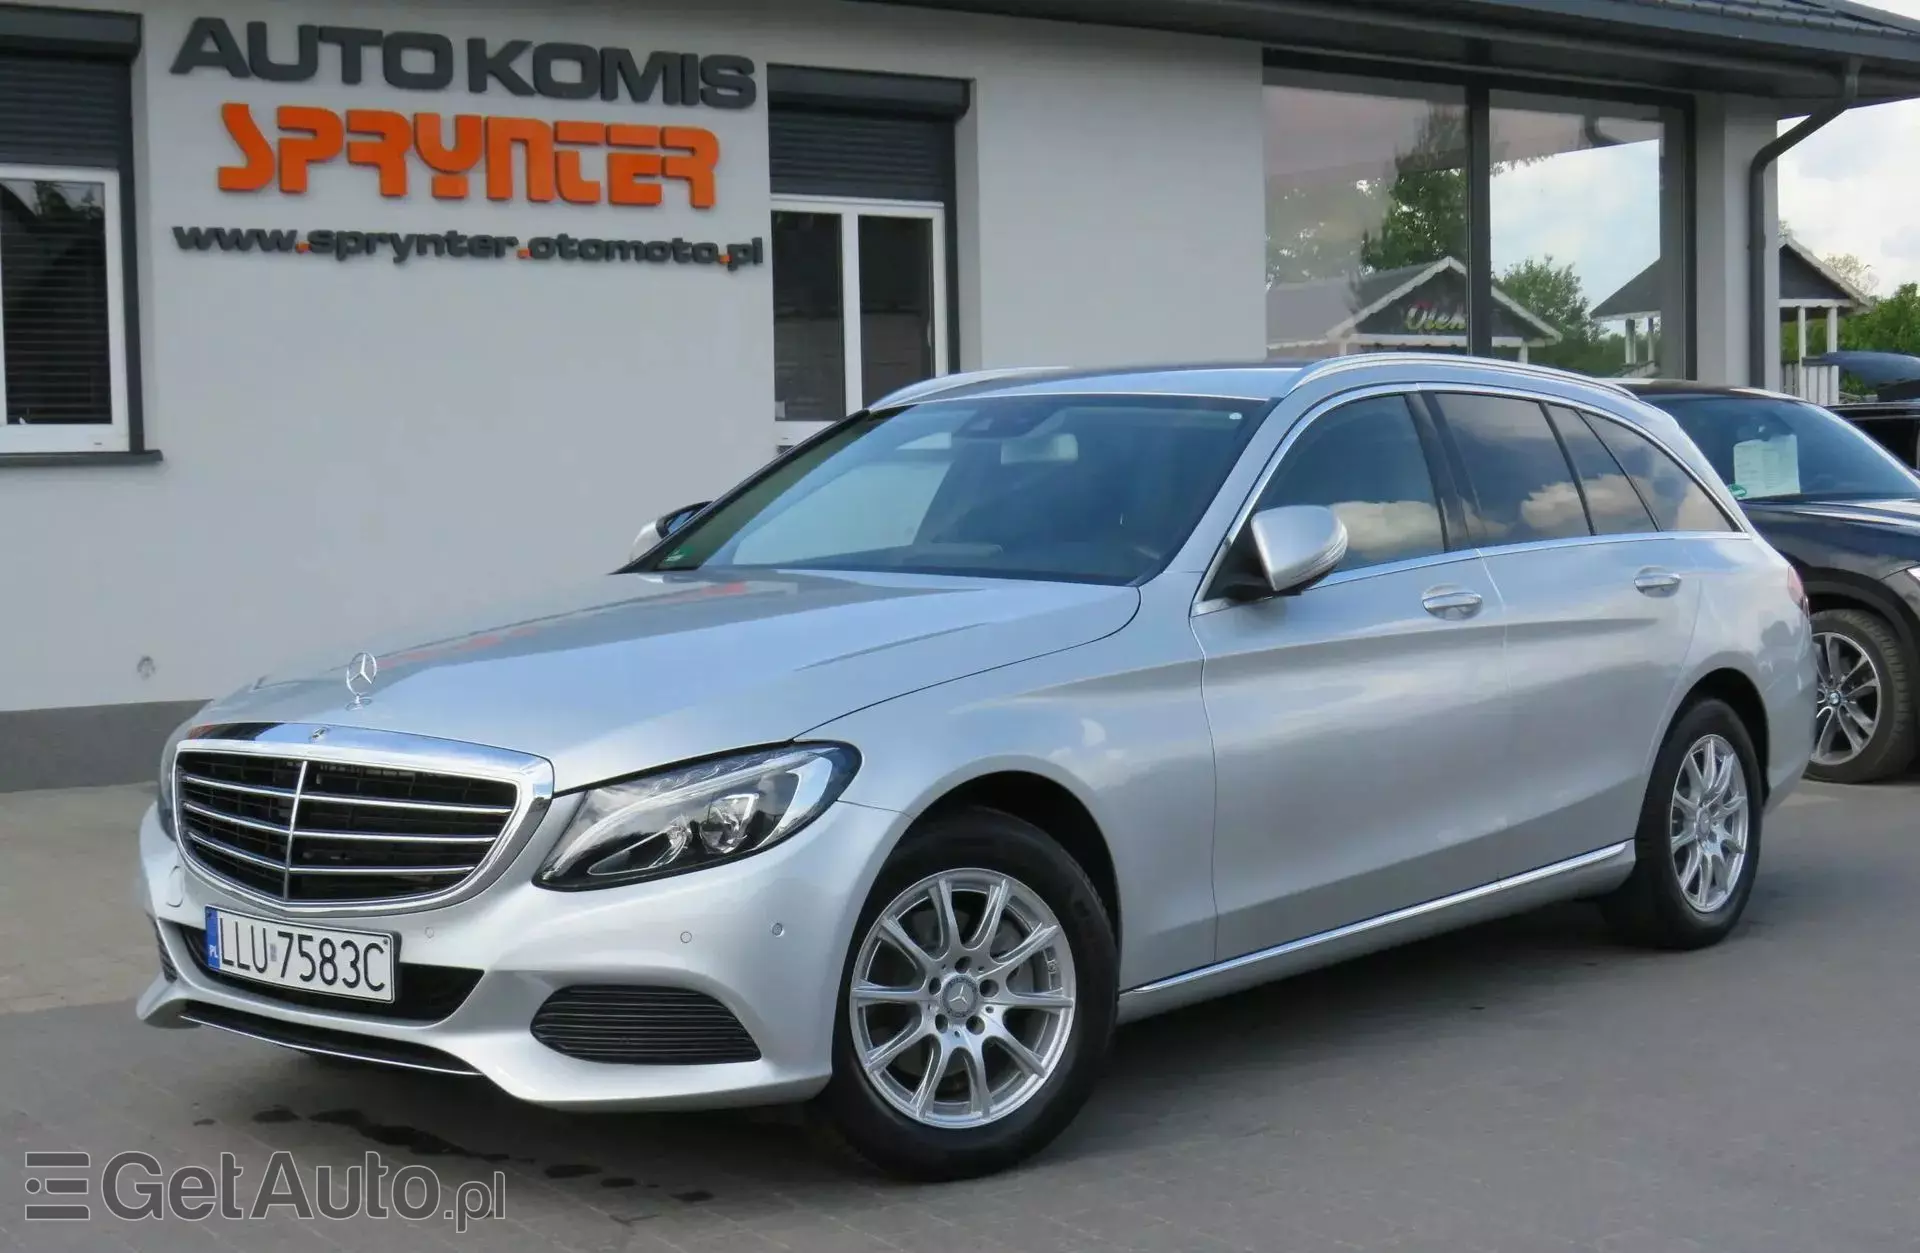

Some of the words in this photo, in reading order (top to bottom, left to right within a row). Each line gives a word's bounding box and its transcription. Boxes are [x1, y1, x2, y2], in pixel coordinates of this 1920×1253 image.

[169, 16, 454, 91] AUTO
[467, 37, 757, 109] KOMIS
[217, 102, 721, 209] SPRYNTER
[172, 225, 764, 272] www.sprynter.otomoto.pl
